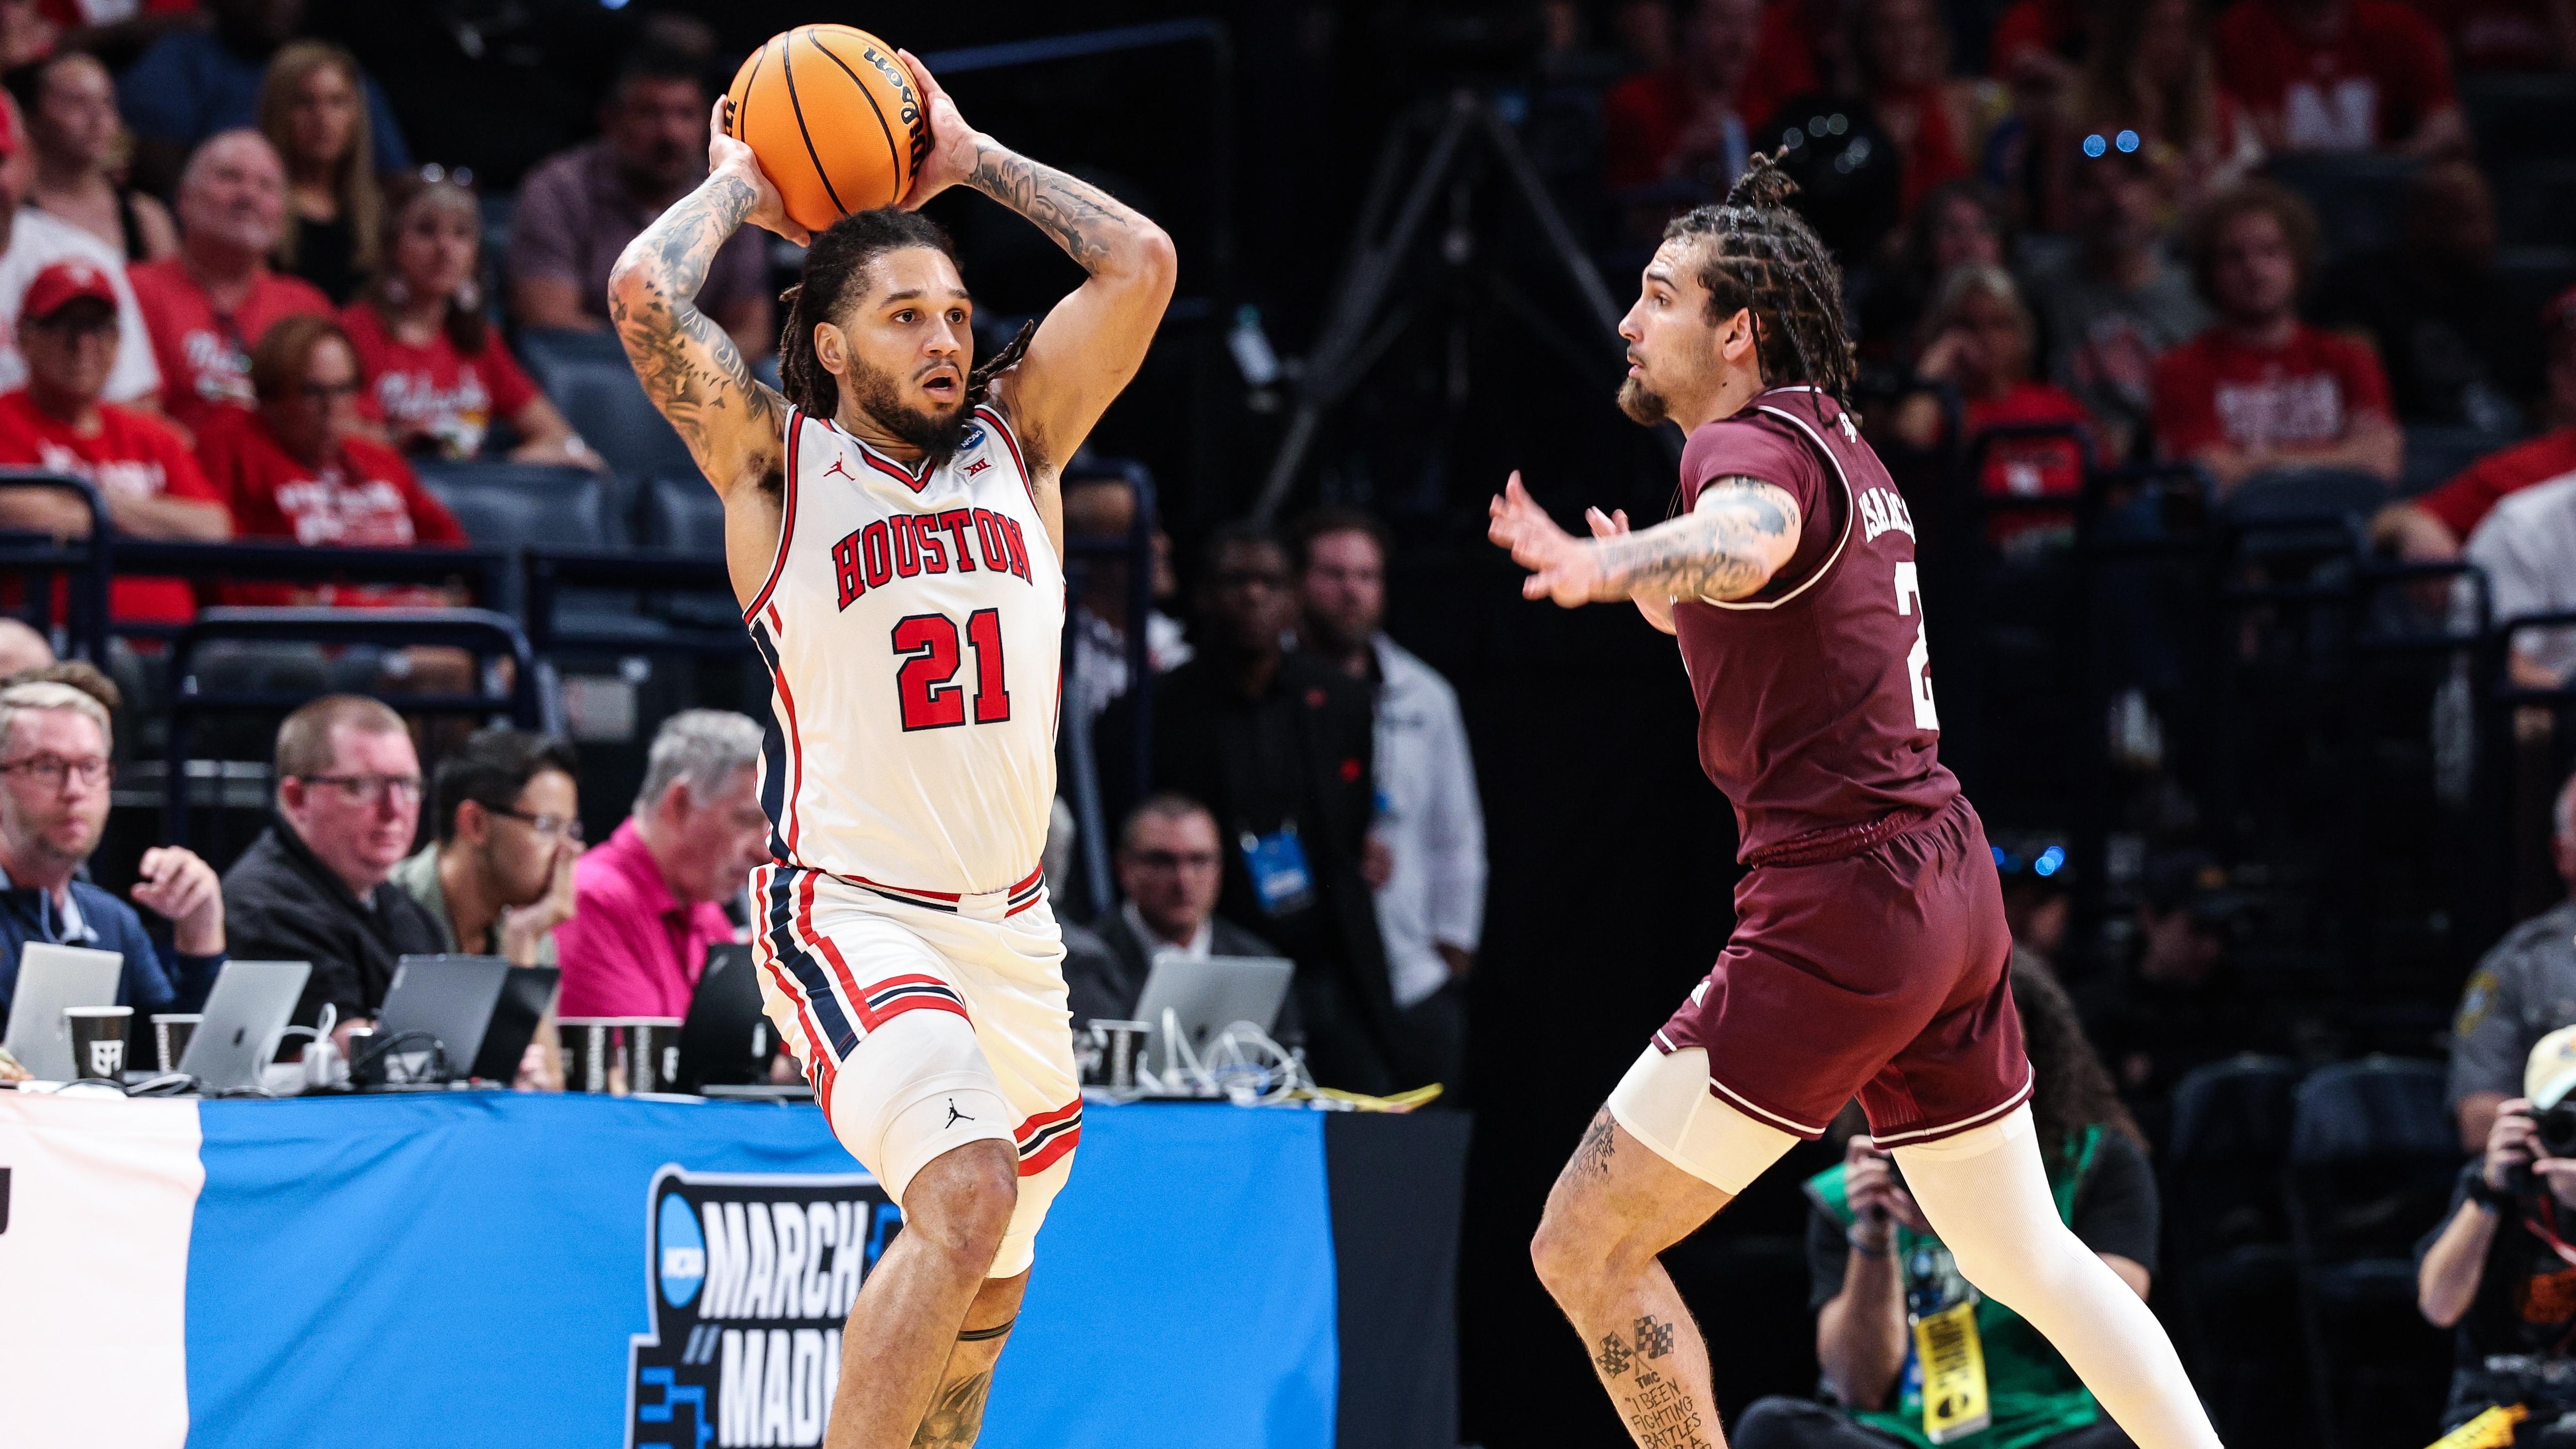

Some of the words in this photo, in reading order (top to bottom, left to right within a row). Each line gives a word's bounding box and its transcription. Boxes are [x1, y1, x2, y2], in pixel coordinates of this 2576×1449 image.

[863, 47, 926, 182] Wilson
[961, 430, 984, 448] NCAA
[963, 458, 992, 477] XII
[832, 507, 1033, 613] HOUSTON
[891, 608, 1010, 732] 21
[698, 1200, 869, 1319] MARCH
[1635, 1371, 1660, 1389] TMC
[1639, 1377, 1681, 1410] BEEN
[1630, 1395, 1693, 1431] FIGHTING
[1641, 1412, 1701, 1449] BATTLES
